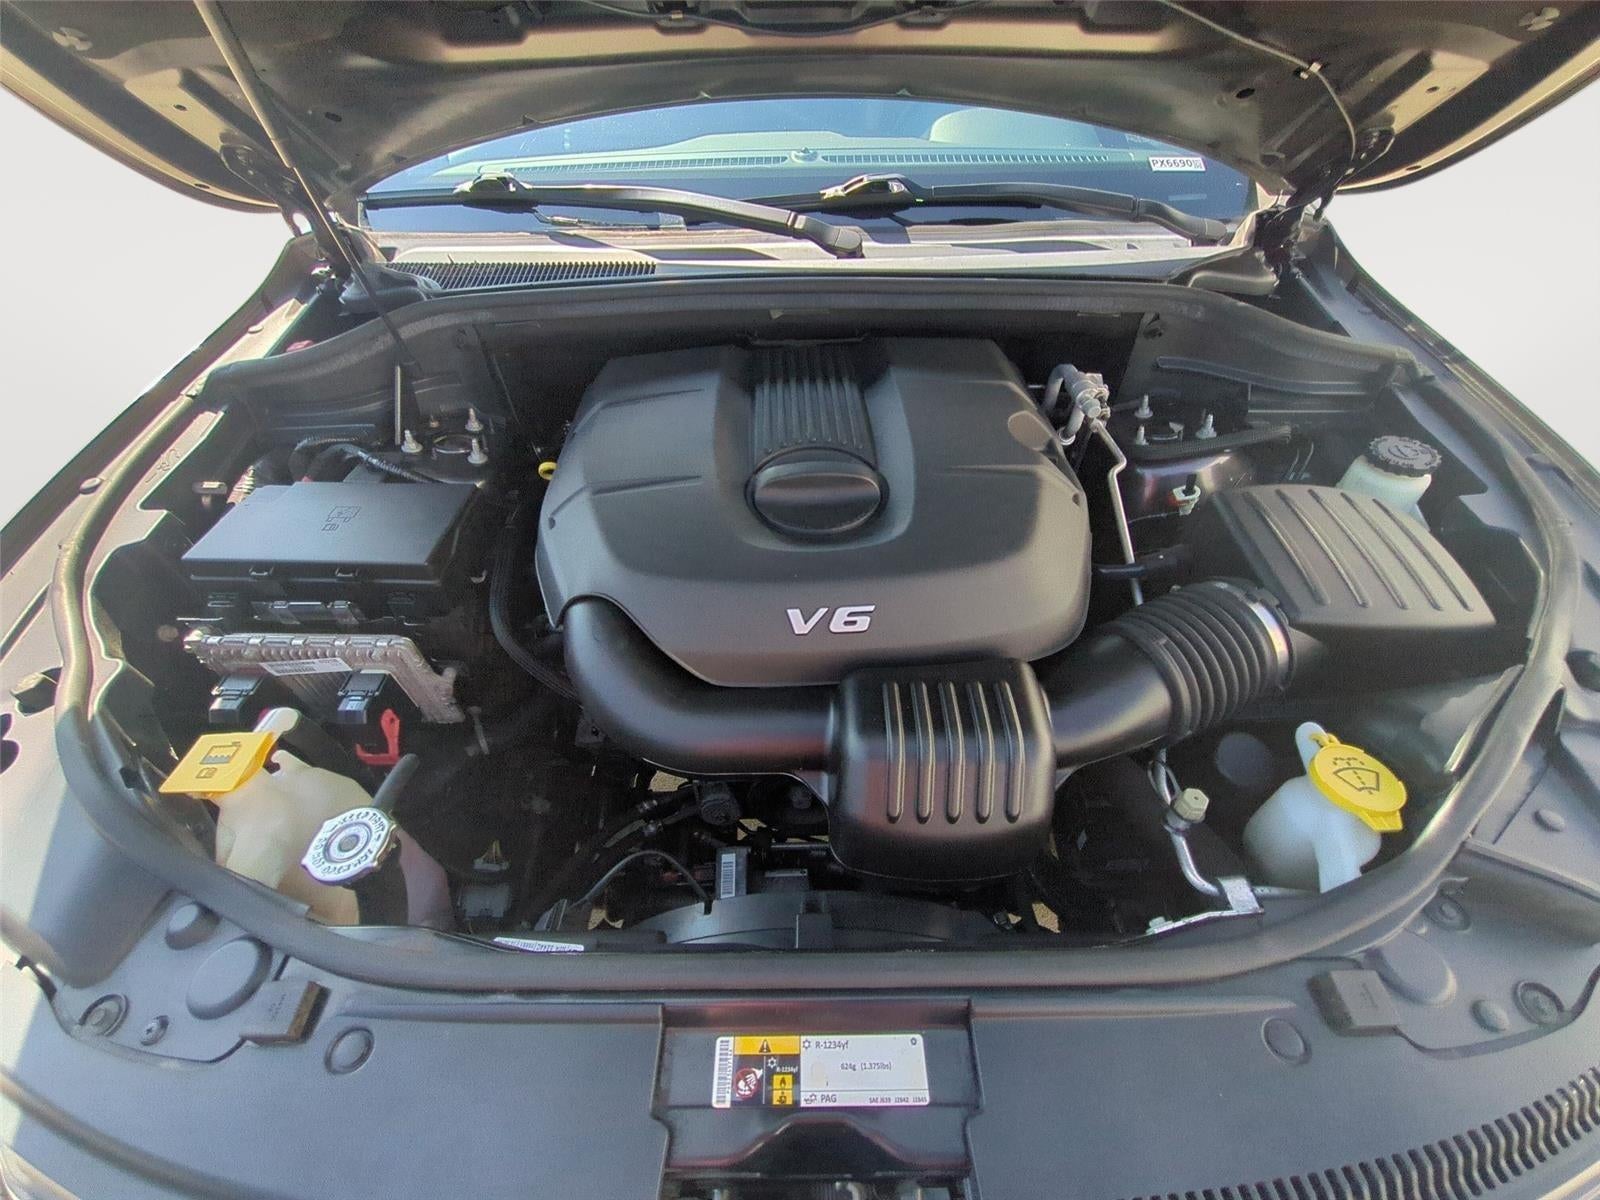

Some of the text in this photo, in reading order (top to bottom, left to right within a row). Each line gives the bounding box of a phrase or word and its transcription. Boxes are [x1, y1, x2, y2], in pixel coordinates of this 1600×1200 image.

[1152, 159, 1193, 168] PX6690
[786, 604, 876, 635] V6
[815, 1039, 849, 1050] R-1234yf
[840, 1062, 892, 1071] 624g (1.375lbs)
[820, 1094, 837, 1103] PAG
